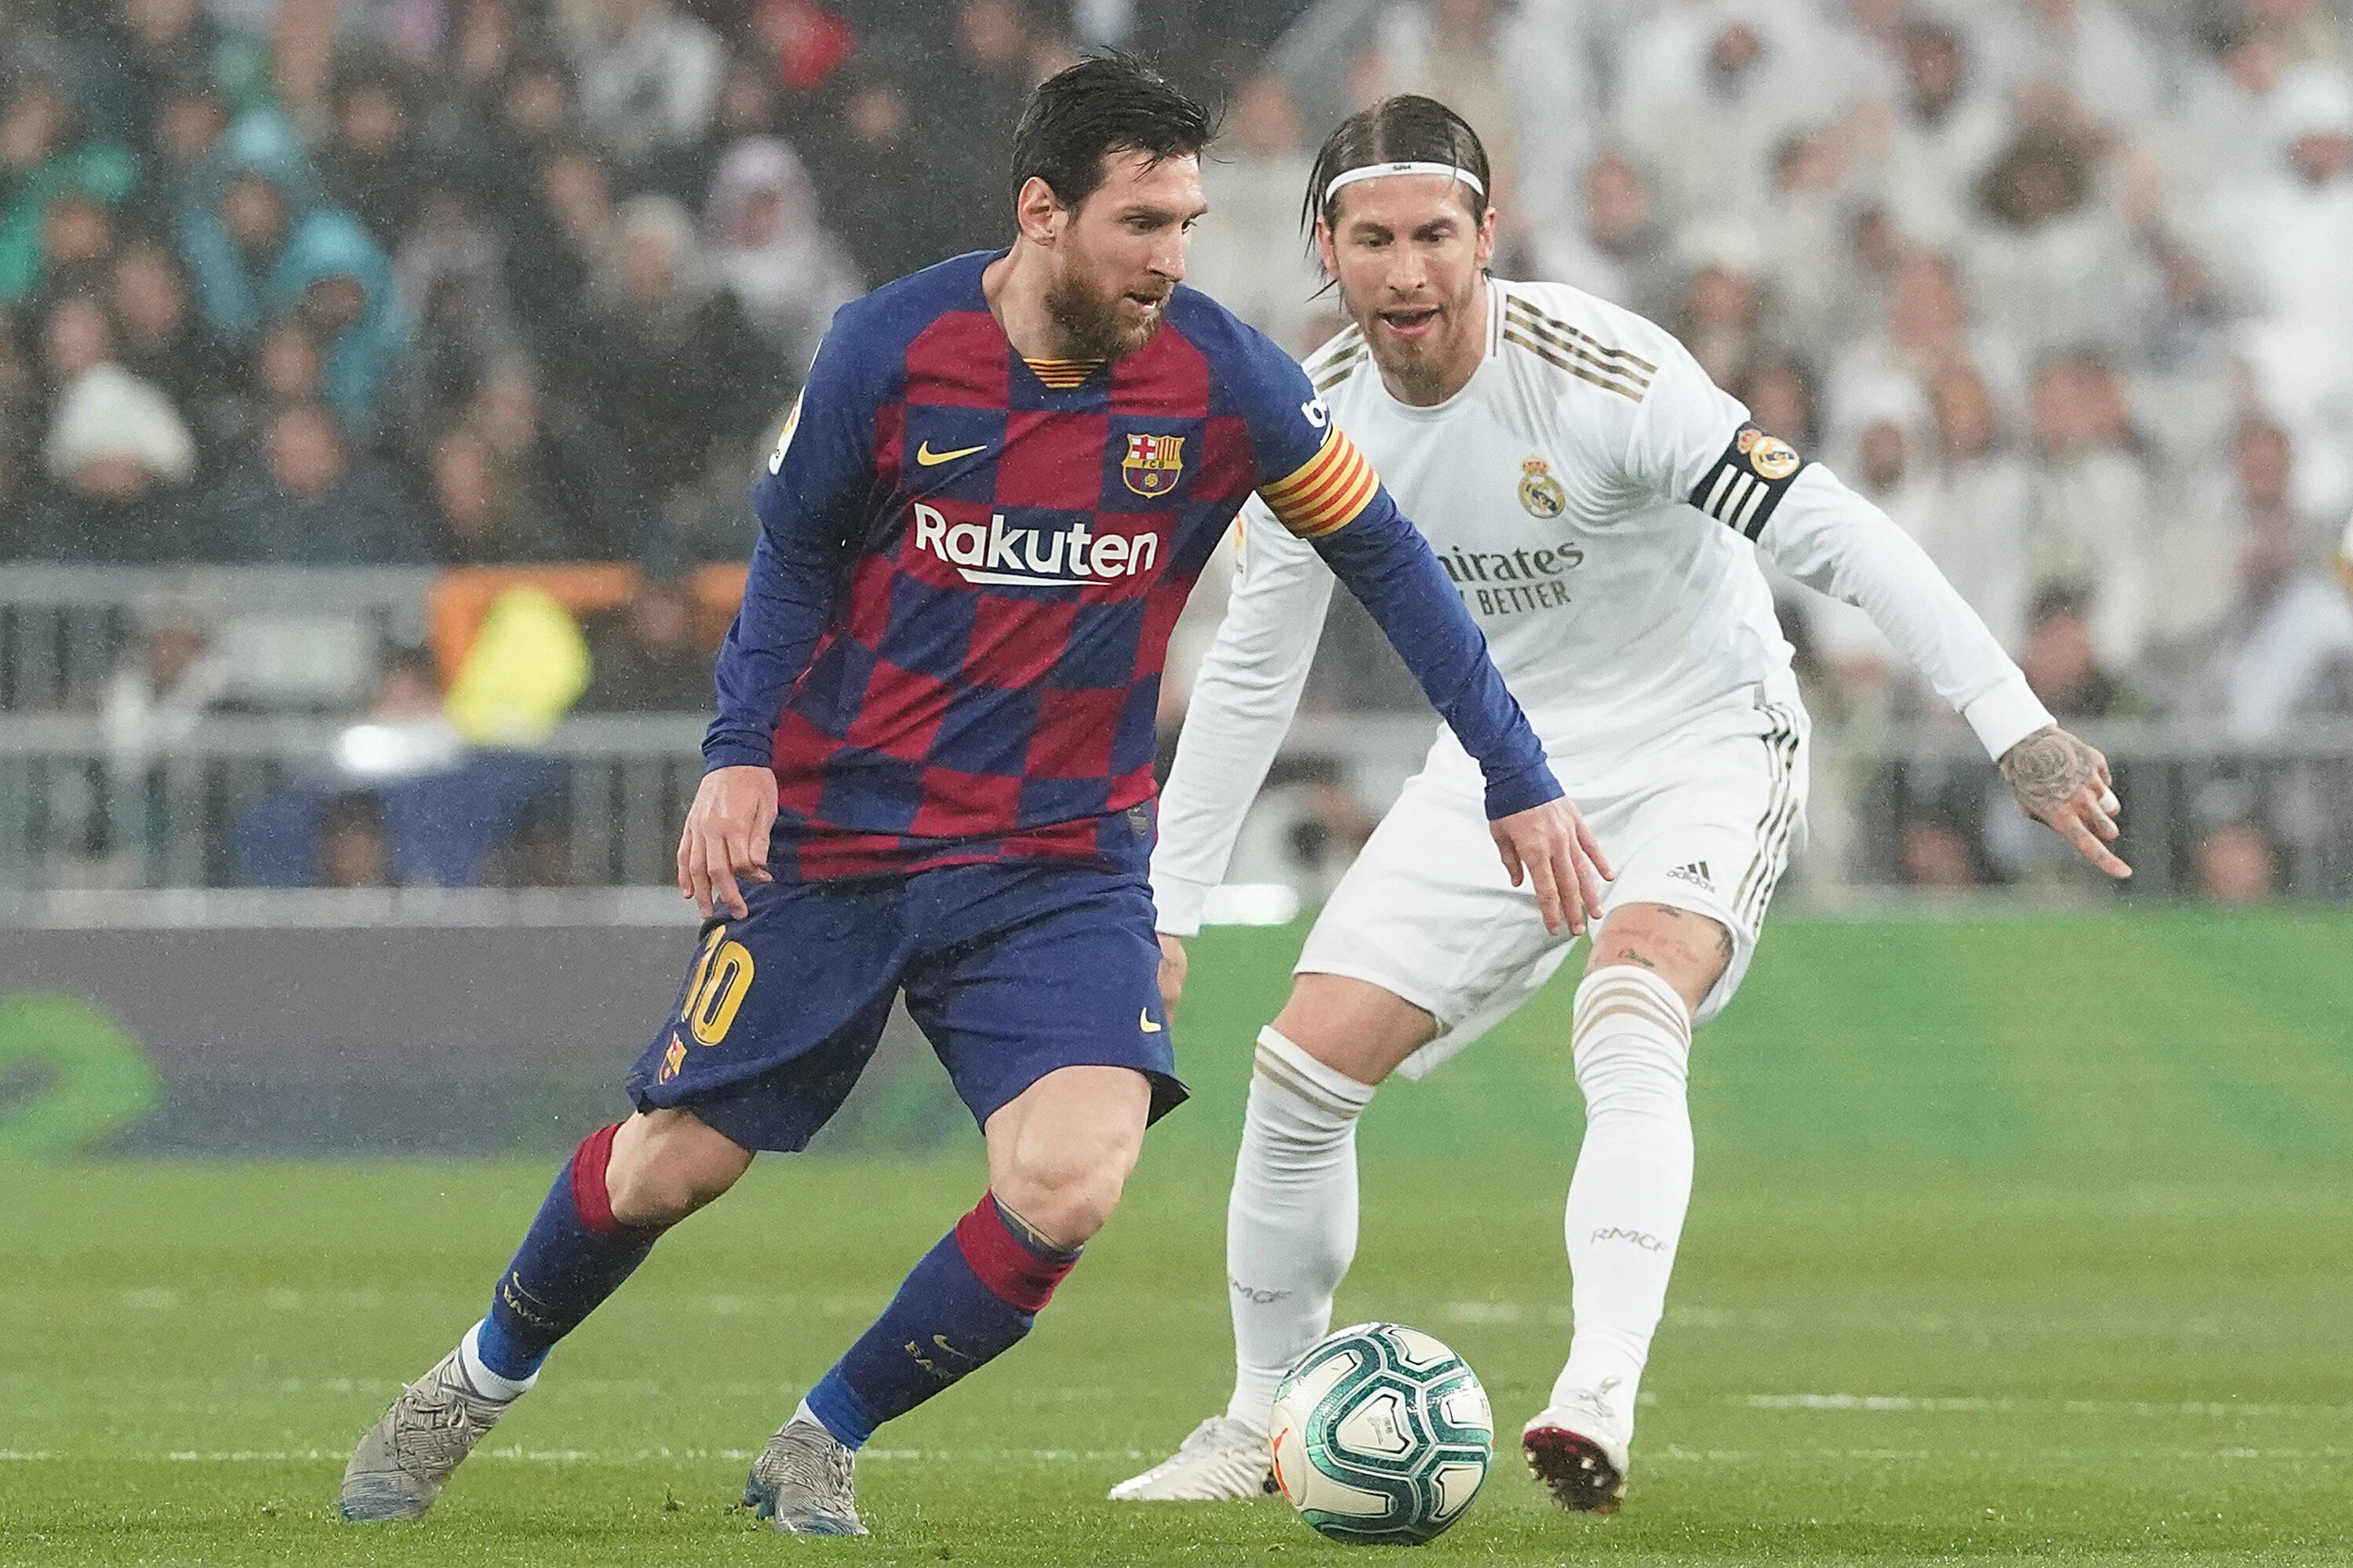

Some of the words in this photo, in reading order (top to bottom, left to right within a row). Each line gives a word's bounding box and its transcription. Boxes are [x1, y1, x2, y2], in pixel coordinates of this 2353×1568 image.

[914, 503, 1158, 578] Rakuten
[1437, 541, 1584, 582] irates
[1476, 580, 1572, 616] BETTER
[1666, 870, 1715, 893] adidas
[681, 924, 755, 1046] 10
